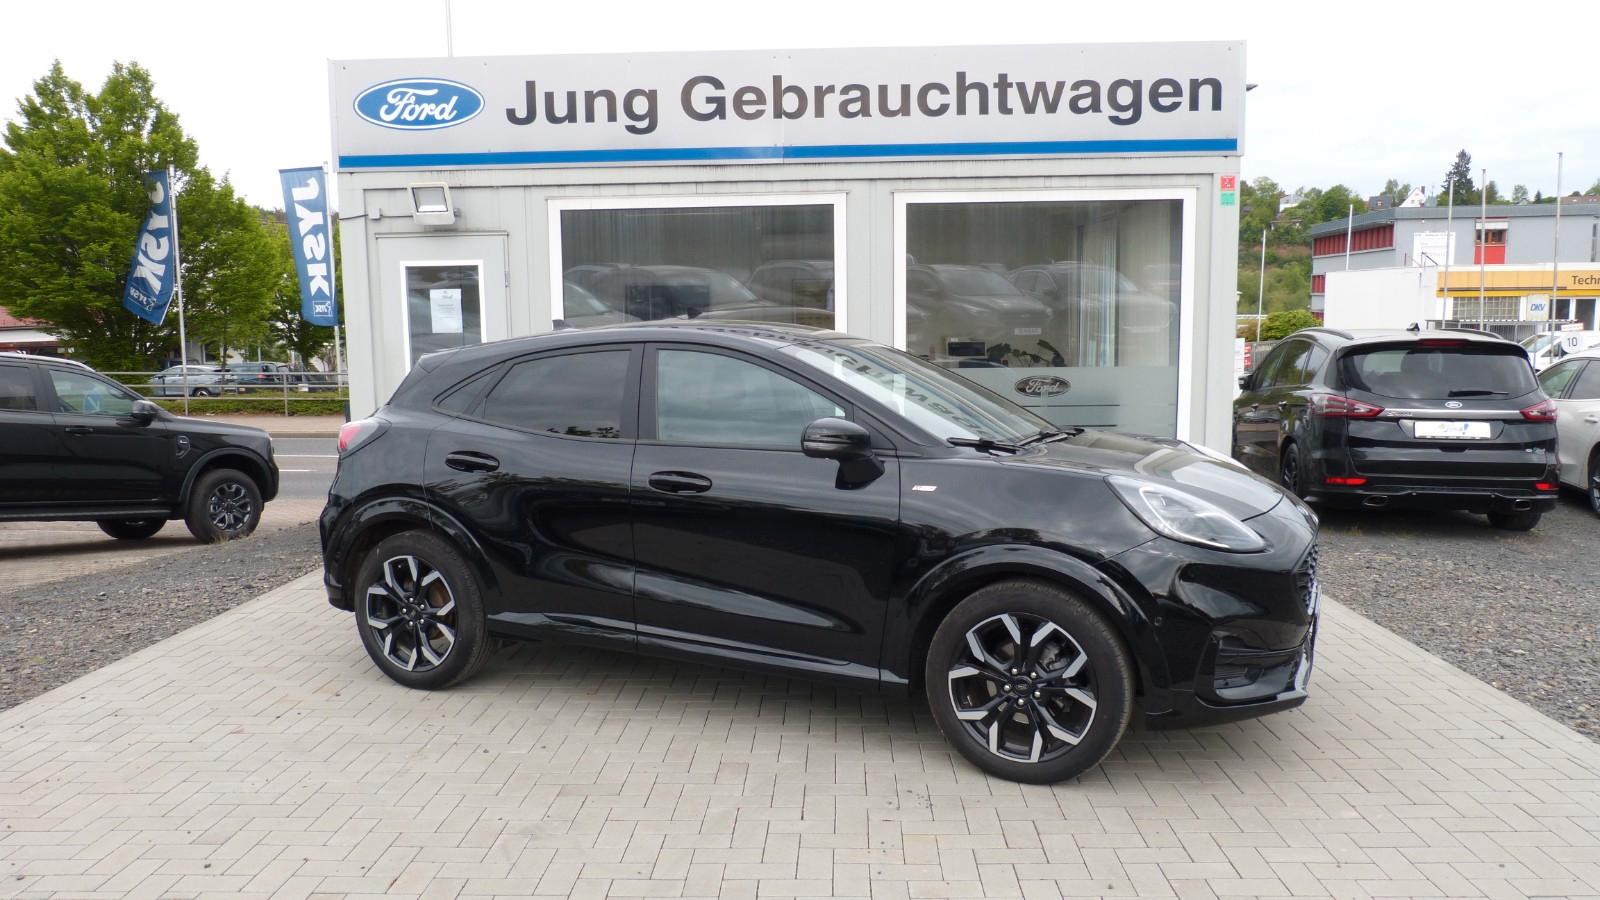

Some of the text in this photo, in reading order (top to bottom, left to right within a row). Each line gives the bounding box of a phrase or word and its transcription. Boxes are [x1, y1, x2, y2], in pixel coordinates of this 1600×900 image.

[380, 88, 457, 122] Ford
[506, 71, 1223, 135] Jung Gebrauchtwagen
[1530, 303, 1546, 312] DKV
[1567, 336, 1578, 347] 10
